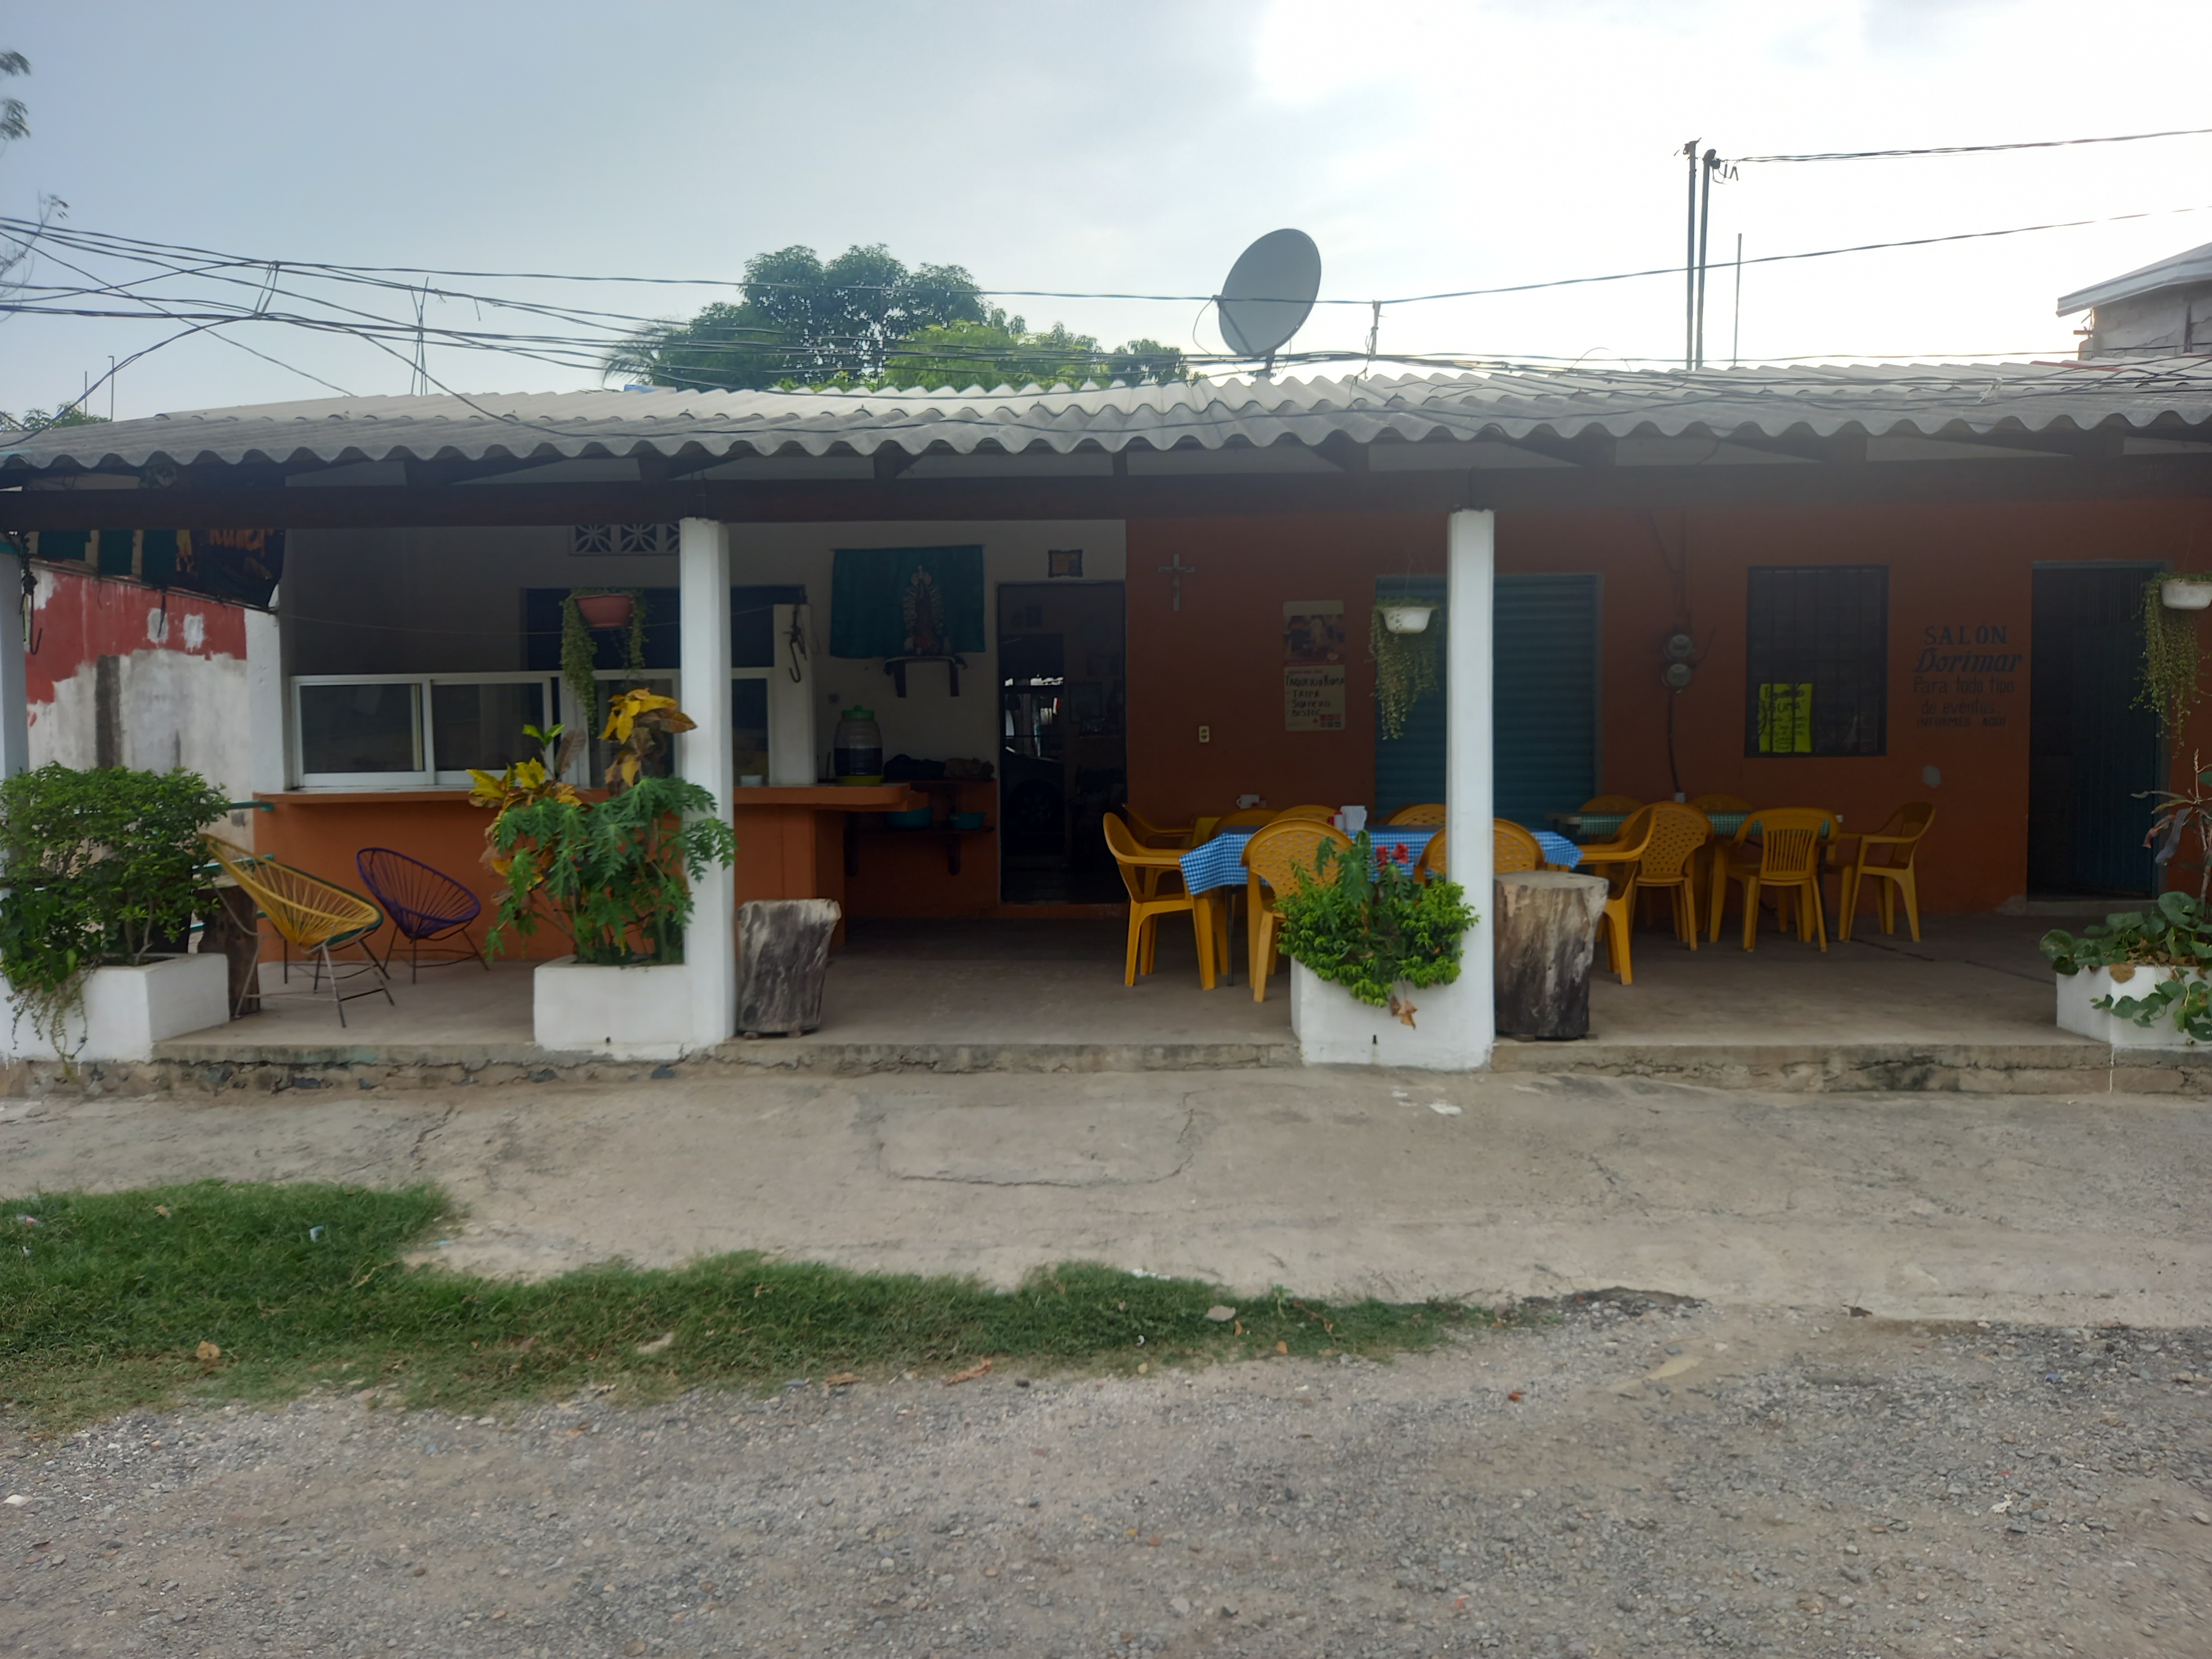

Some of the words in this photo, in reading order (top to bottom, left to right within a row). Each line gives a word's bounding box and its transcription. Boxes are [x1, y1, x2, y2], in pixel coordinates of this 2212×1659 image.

[1913, 647, 2023, 673] Dorimar
[1913, 675, 1947, 693] Para
[1955, 675, 1984, 693] todo
[1989, 675, 2015, 694] tipo
[1292, 690, 1319, 698] TRIPA
[1922, 698, 1936, 714] de
[1917, 716, 1971, 727] INFORMES
